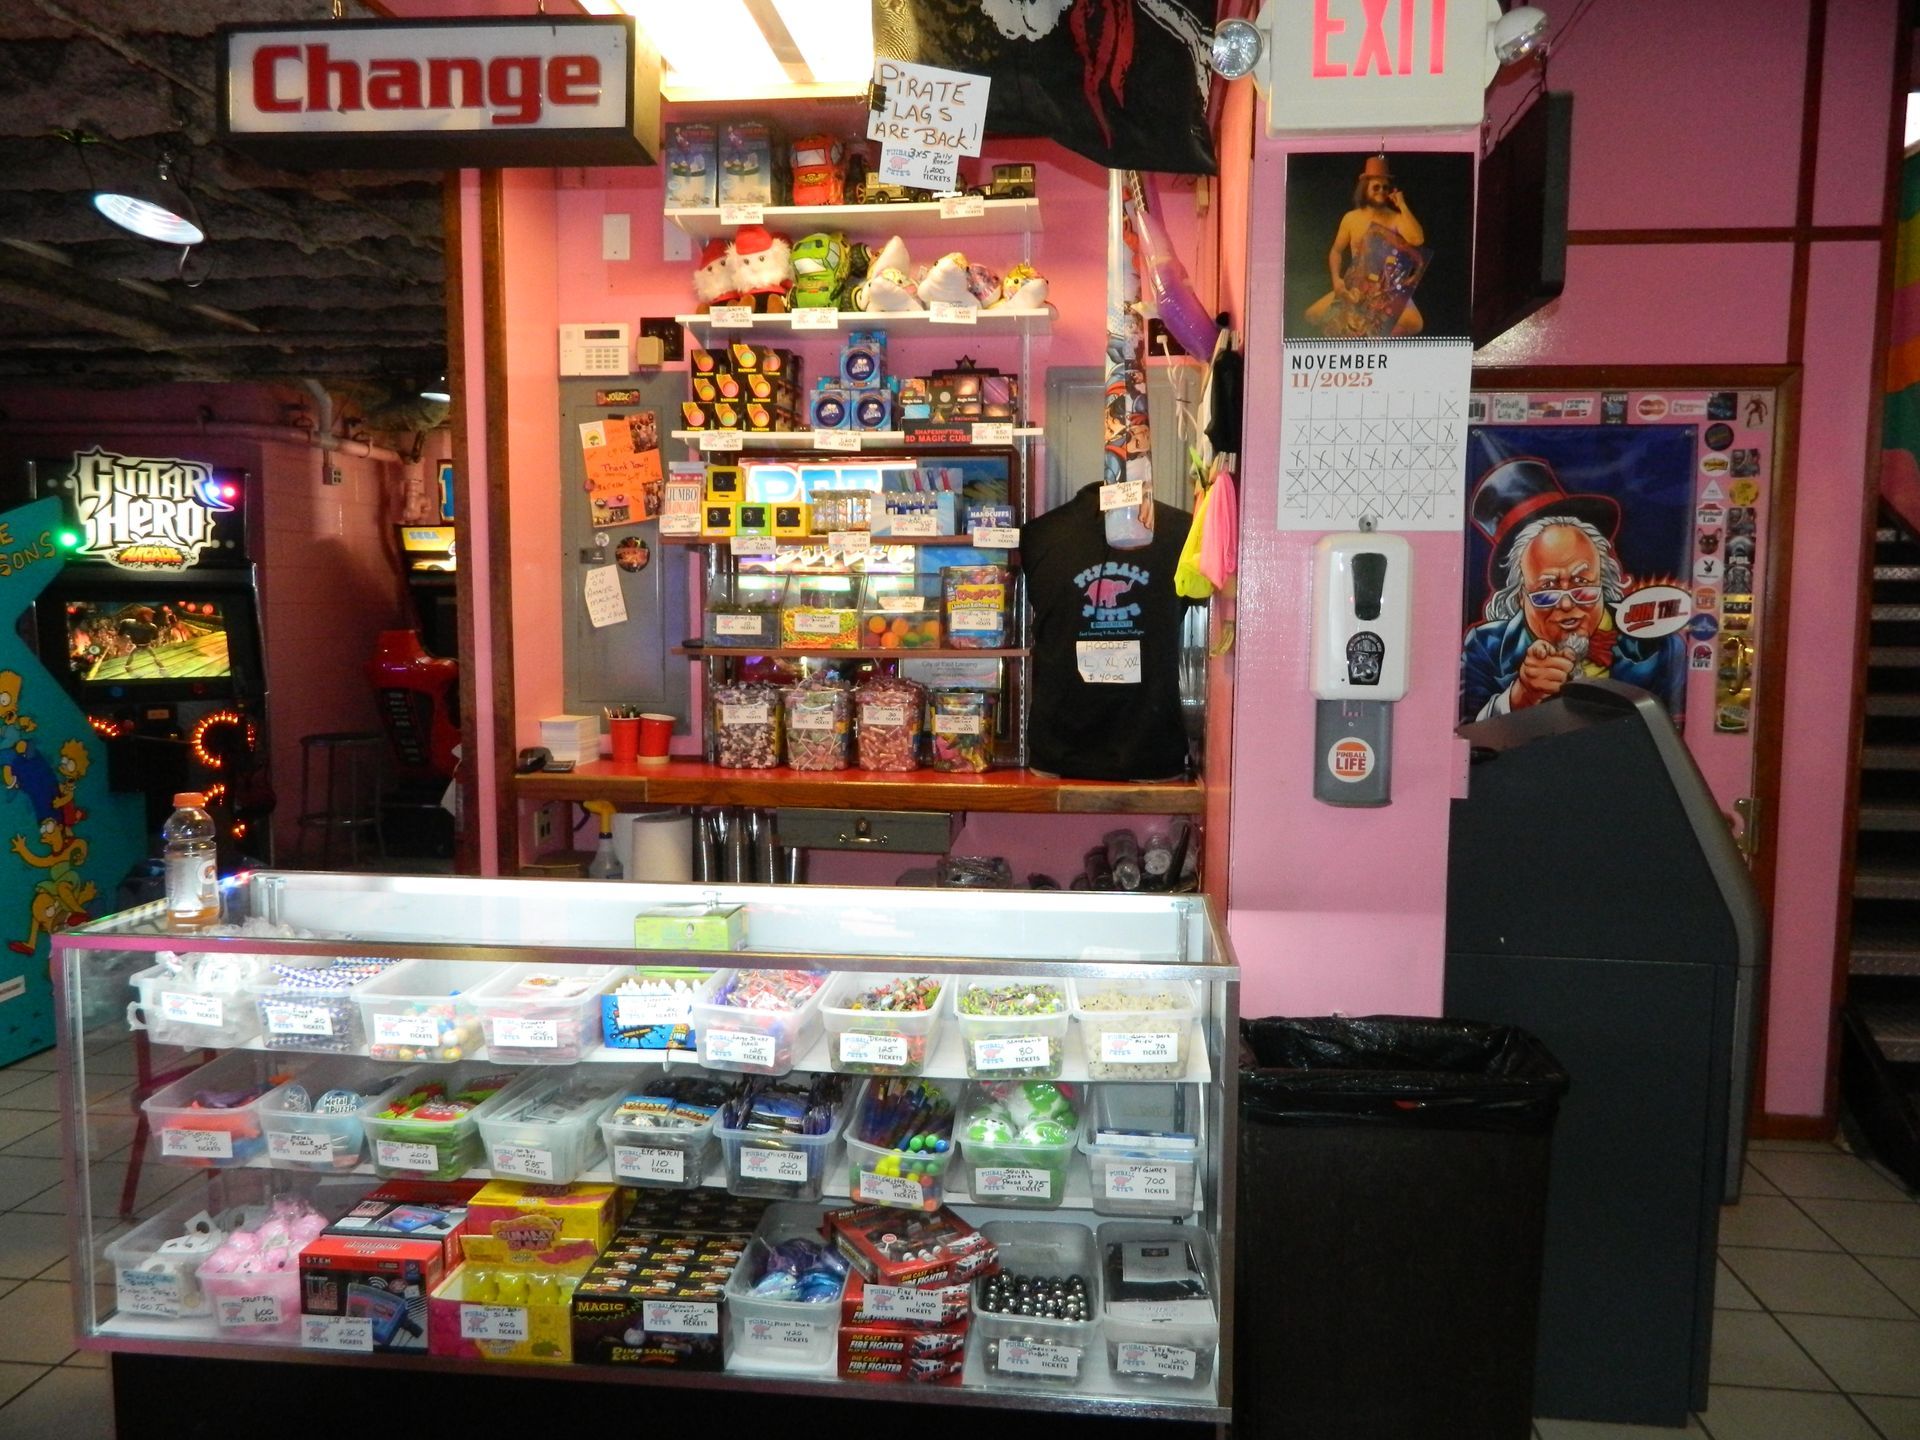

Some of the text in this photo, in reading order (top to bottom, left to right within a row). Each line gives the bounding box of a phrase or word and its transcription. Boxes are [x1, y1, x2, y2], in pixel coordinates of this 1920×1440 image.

[1312, 0, 1446, 78] EXIT
[253, 43, 599, 125] Change
[875, 122, 909, 139] ARE
[923, 173, 951, 182] TICKETS
[1292, 355, 1388, 369] NOVEMBER
[1291, 370, 1373, 392] 11/2025
[668, 487, 697, 502] JUMBO
[120, 547, 183, 564] ARCADE
[1086, 642, 1129, 651] HOODIE
[1105, 658, 1117, 667] XL
[1335, 758, 1366, 770] LIFE
[1019, 1047, 1033, 1056] 80
[526, 1167, 546, 1176] TICKETS
[778, 1168, 802, 1176] TICKETS
[1144, 1177, 1166, 1185] 700
[894, 1192, 918, 1200] TICKETS
[917, 1271, 948, 1284] FIGHTER
[577, 1302, 625, 1311] MAGIC
[850, 1341, 903, 1350] FIRE FIGHTER
[849, 1362, 902, 1372] FIRE FIGHTER
[1042, 1361, 1067, 1369] TICKETS
[1158, 1363, 1185, 1371] TICKETS
